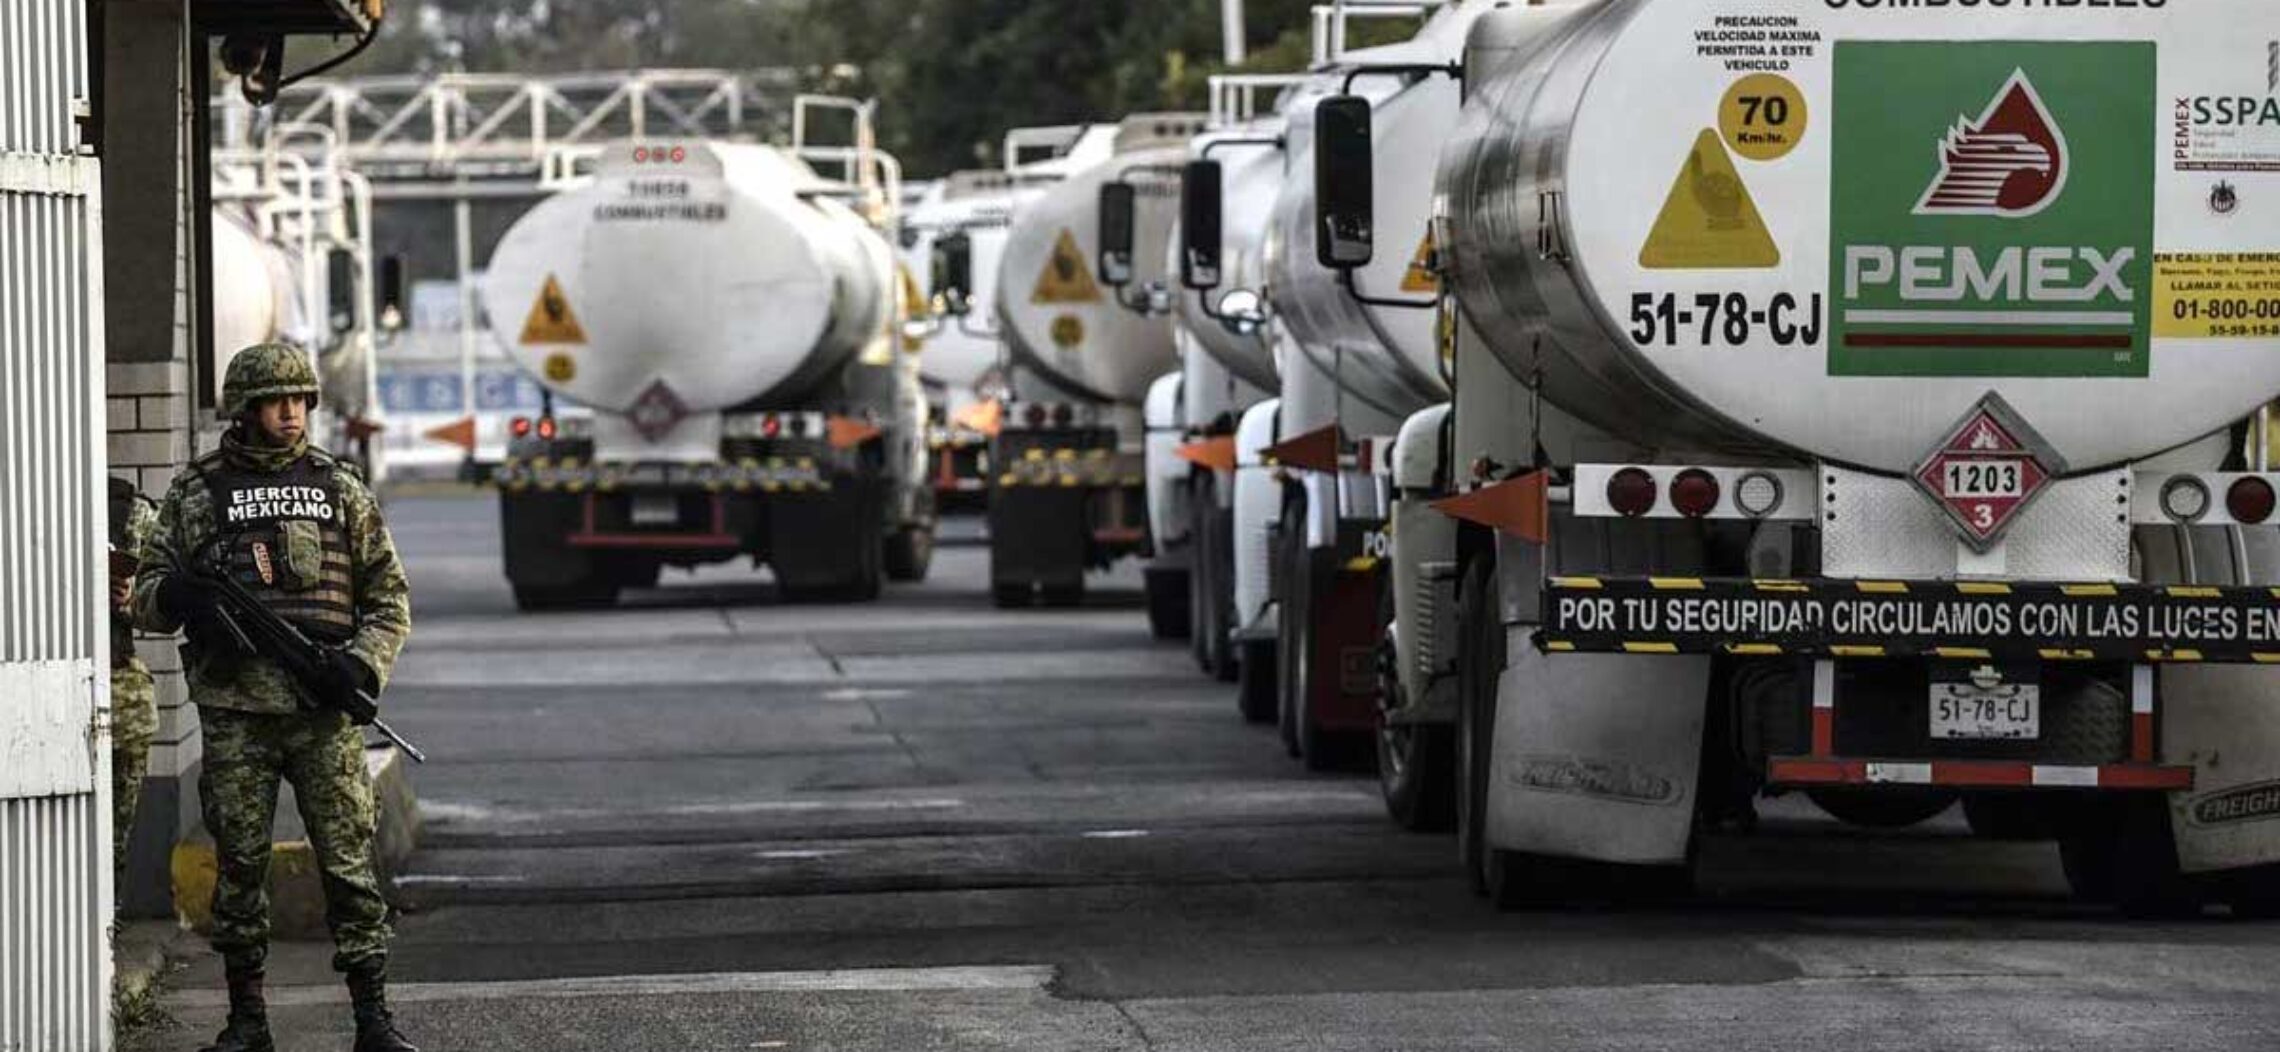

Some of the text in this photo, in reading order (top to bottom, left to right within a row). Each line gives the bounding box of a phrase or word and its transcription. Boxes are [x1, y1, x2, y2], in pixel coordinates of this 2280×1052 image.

[1715, 16, 1798, 27] PRECAUCION
[1694, 31, 1821, 41] VELOCIDAD MAXIMA
[1697, 45, 1813, 56] PERMITIDA A ESTE
[1725, 60, 1789, 70] VEHICULO
[1737, 96, 1788, 126] 70
[2193, 96, 2280, 126] SSPA
[2175, 97, 2190, 158] PEMEX
[2154, 253, 2172, 262] EN
[1845, 245, 2135, 300] PEMEX
[2170, 281, 2221, 291] LLAMAR
[1630, 292, 1822, 346] 51-78-CJ
[2173, 299, 2280, 319] 01-800-00
[1950, 465, 2016, 492] 1203
[231, 486, 326, 505] EJERCITO
[228, 501, 333, 522] MEXICANO
[1974, 504, 1994, 527] 3
[1559, 598, 1615, 632] POR
[1623, 599, 1657, 631] TU
[1832, 600, 2011, 636] CIRCULAMOS
[2019, 602, 2078, 637] CON
[2087, 605, 2140, 638] LAS
[2148, 605, 2238, 640] LUCES
[2247, 607, 2280, 641] EN
[1939, 699, 2030, 722] 51-78-CJ
